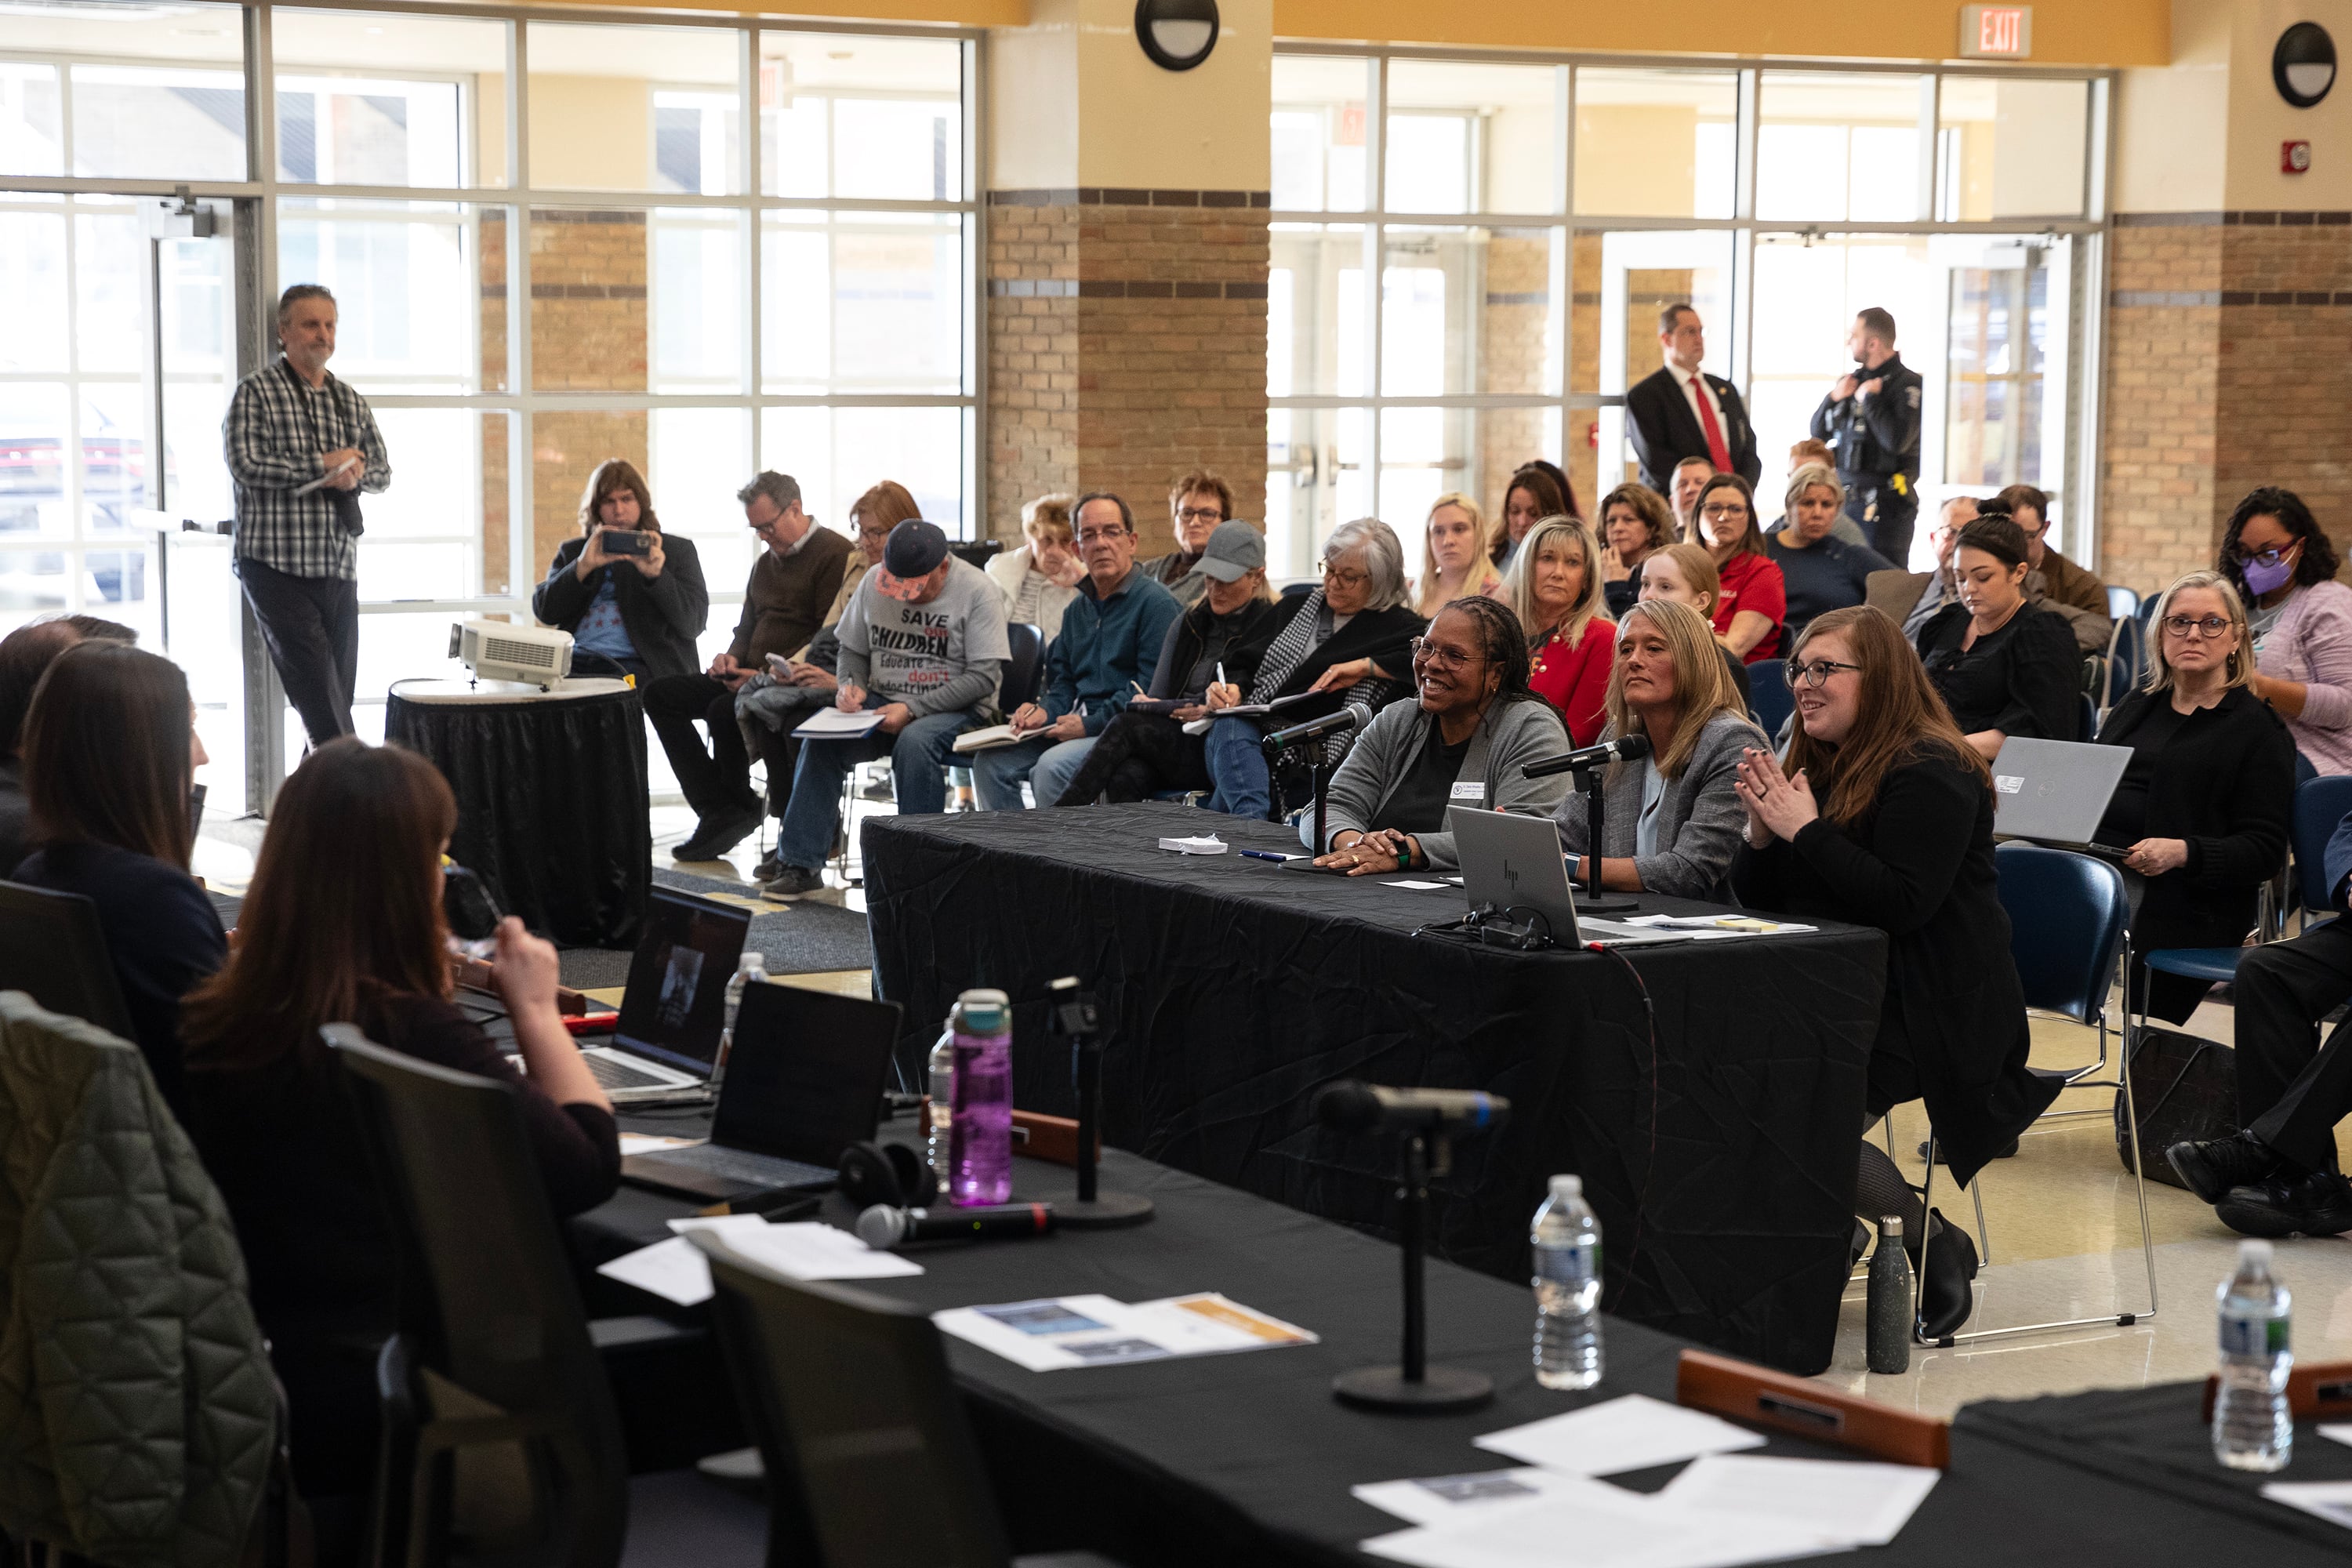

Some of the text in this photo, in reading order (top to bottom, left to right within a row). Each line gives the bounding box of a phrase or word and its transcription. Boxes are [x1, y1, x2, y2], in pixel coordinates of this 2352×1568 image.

[1980, 9, 2022, 53] EXIT
[902, 608, 949, 628] SAVE
[871, 625, 949, 657] CHILDREN
[880, 654, 924, 669] Educate
[908, 670, 949, 682] don't
